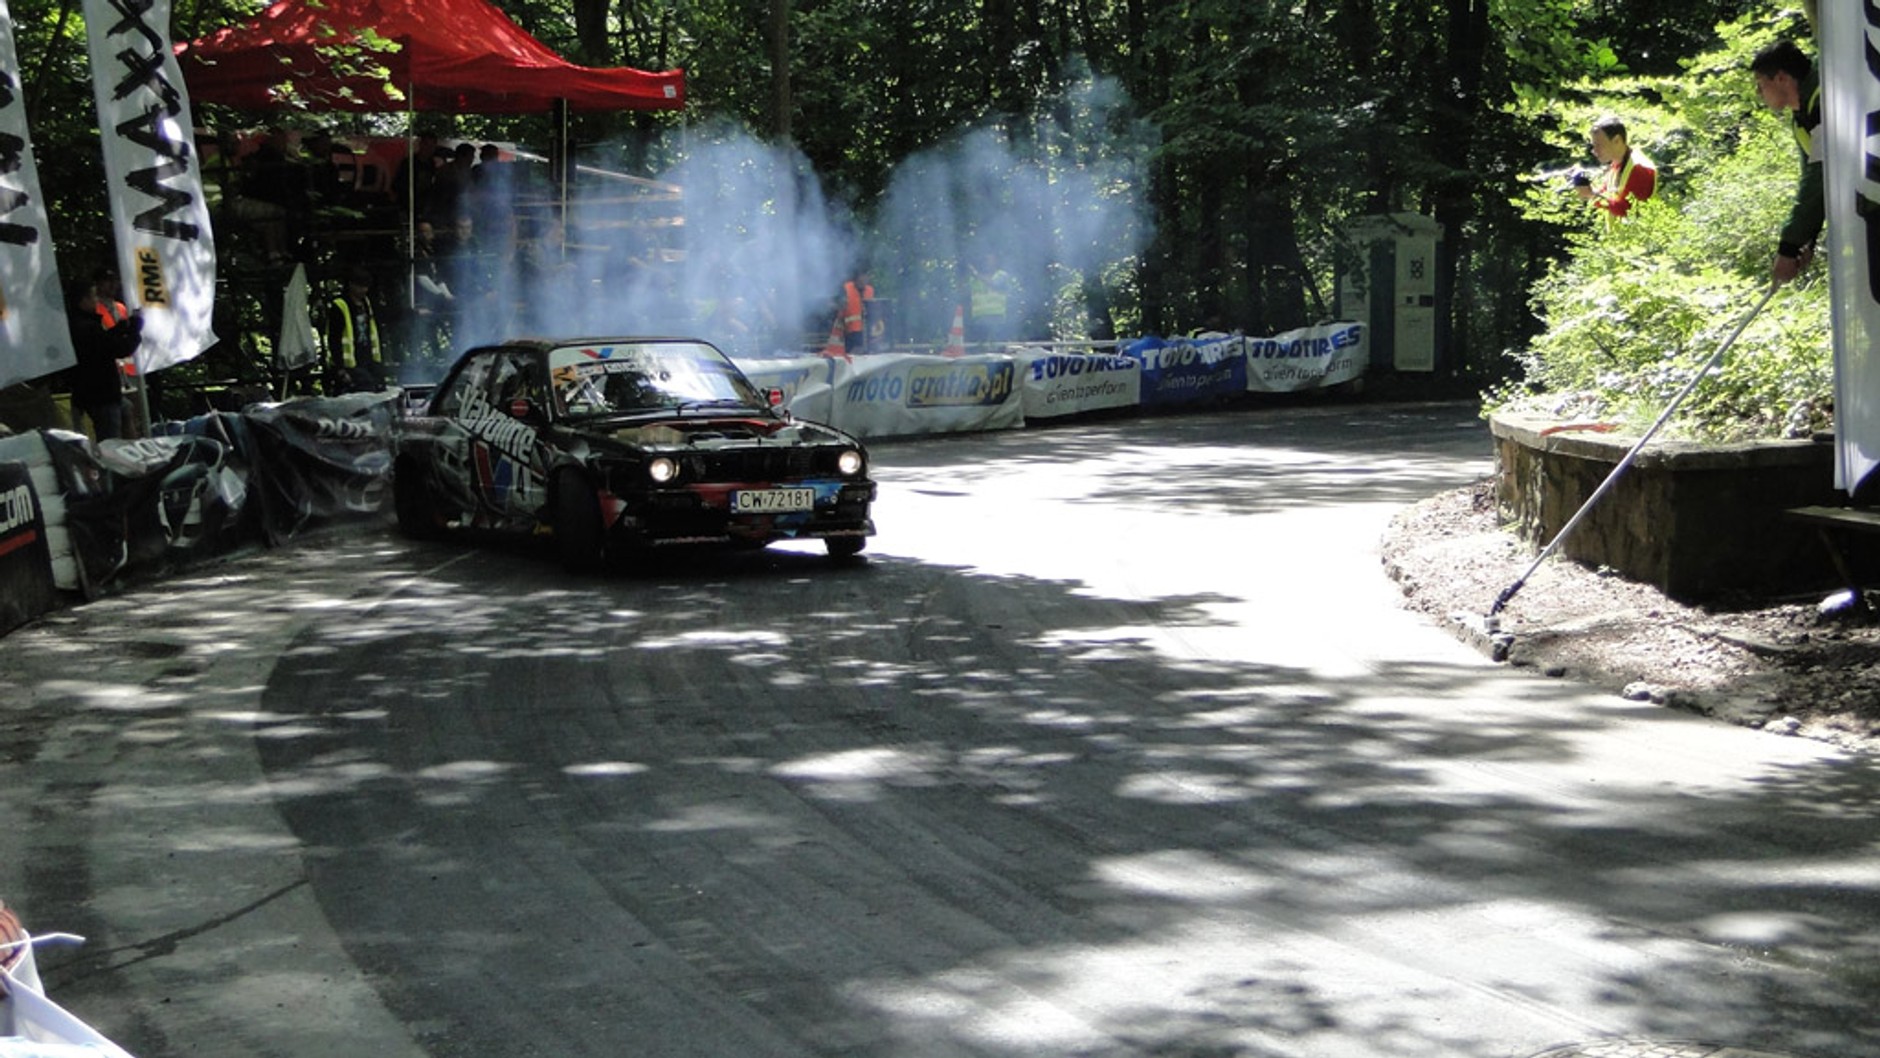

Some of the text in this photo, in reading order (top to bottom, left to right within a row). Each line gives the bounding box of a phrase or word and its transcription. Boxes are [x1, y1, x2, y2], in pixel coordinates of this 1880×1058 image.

[137, 251, 165, 303] RMF
[1030, 355, 1085, 381] TOYO
[848, 371, 904, 402] moto
[739, 491, 811, 508] CW 72181
